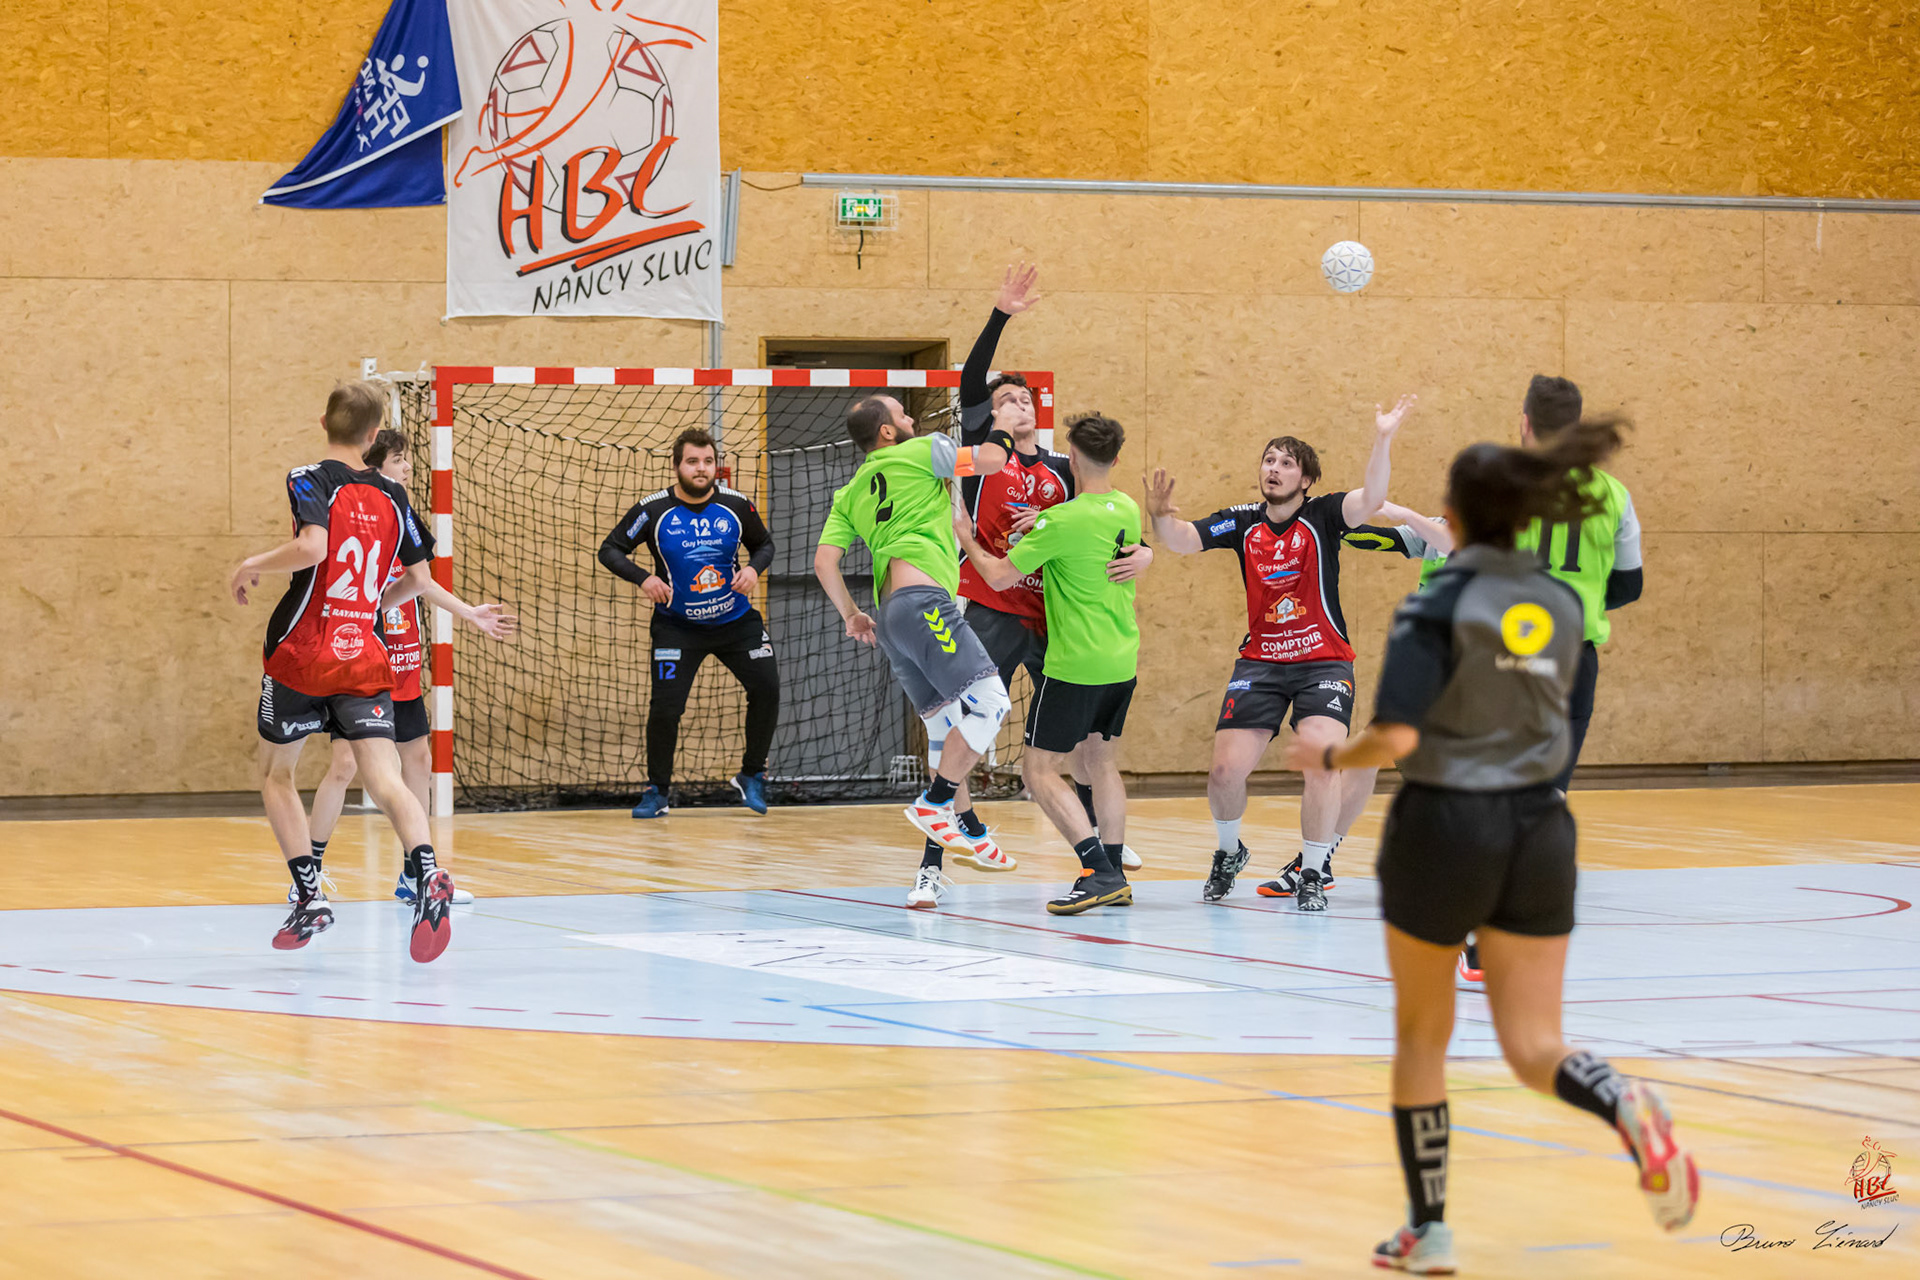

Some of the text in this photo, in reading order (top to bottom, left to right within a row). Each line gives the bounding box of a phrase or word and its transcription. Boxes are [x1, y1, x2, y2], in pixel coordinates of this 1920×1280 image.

[498, 135, 695, 259] HBC
[532, 239, 713, 314] NANCY SLUC
[871, 472, 894, 526] 2
[1006, 486, 1024, 501] Guy
[690, 518, 711, 537] 12
[682, 538, 723, 548] Guy Hoquet
[1273, 539, 1285, 560] 2
[1257, 556, 1300, 573] Guy Hoquet
[332, 608, 361, 619] RAYAN
[1261, 631, 1322, 652] COMPTOIR
[1283, 629, 1294, 637] LE
[390, 650, 420, 664] MPTOIR
[658, 661, 676, 680] 12
[1223, 698, 1235, 719] 2
